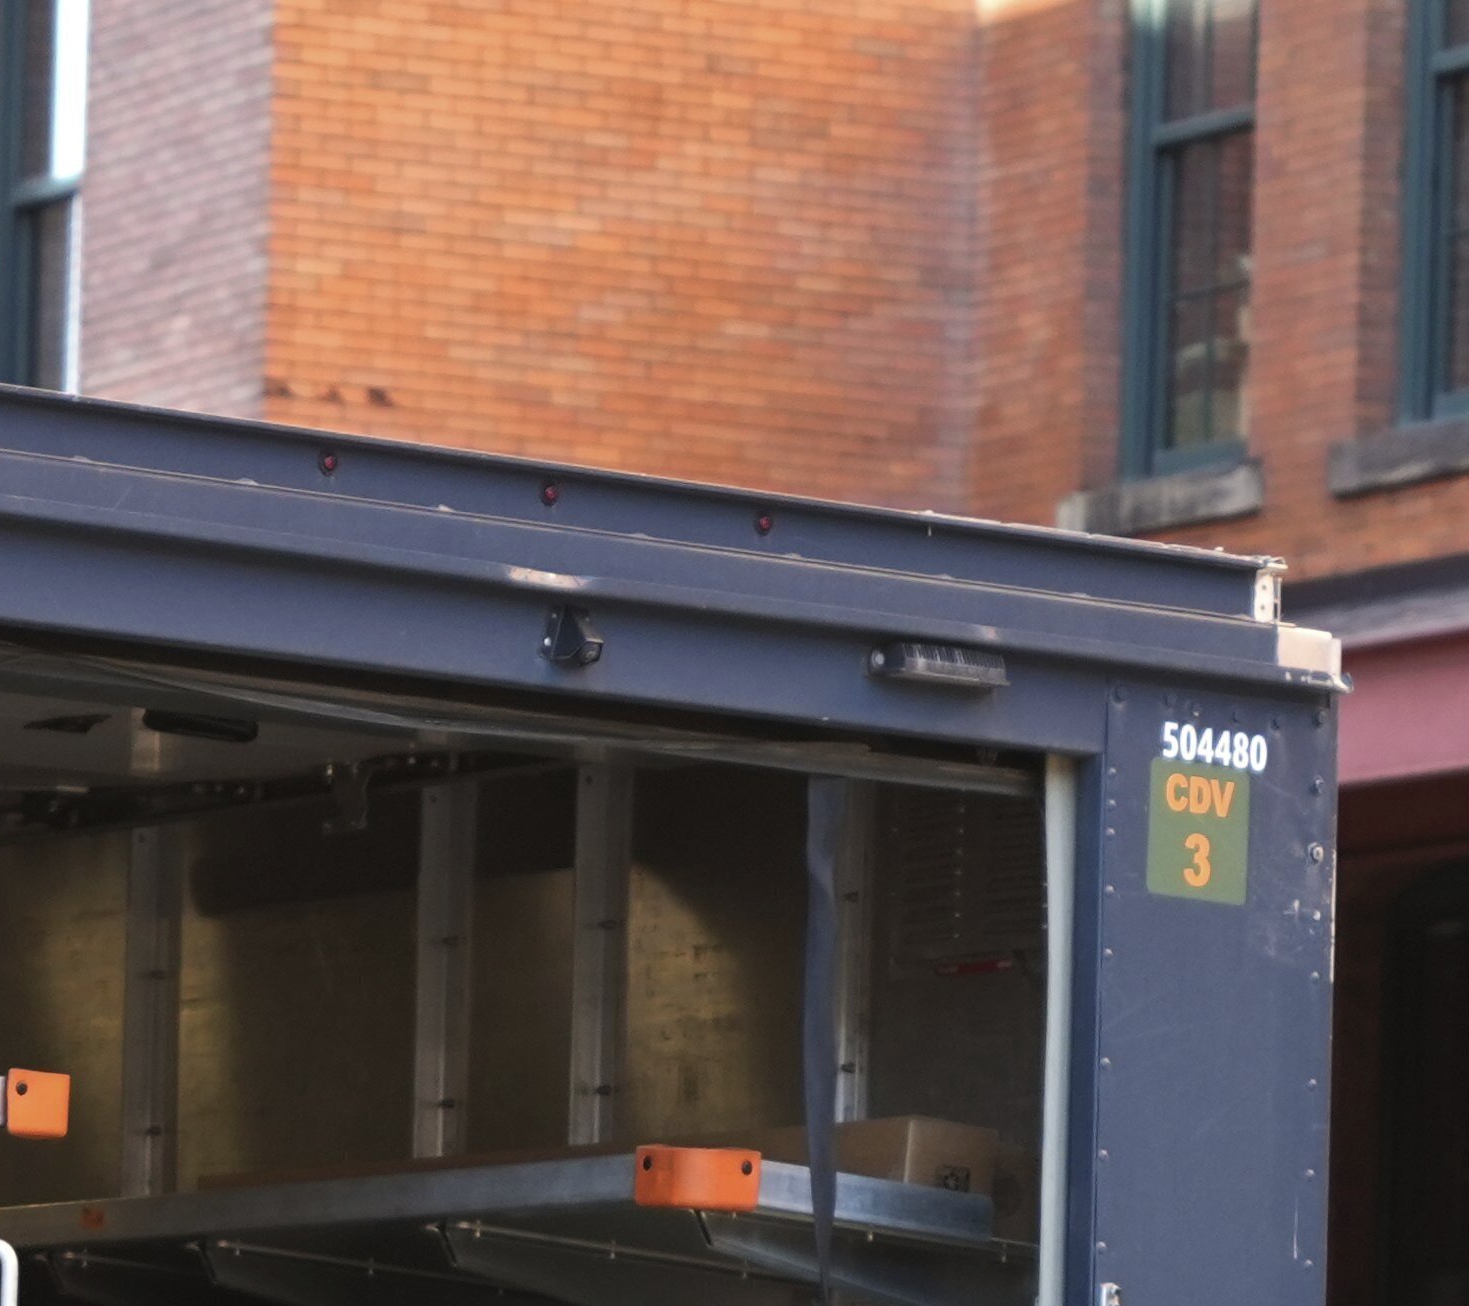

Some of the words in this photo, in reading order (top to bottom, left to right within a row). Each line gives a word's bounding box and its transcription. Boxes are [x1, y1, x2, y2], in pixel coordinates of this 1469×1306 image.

[1162, 720, 1268, 772] 504480
[1165, 772, 1235, 818] CDV
[1182, 832, 1212, 887] 3
